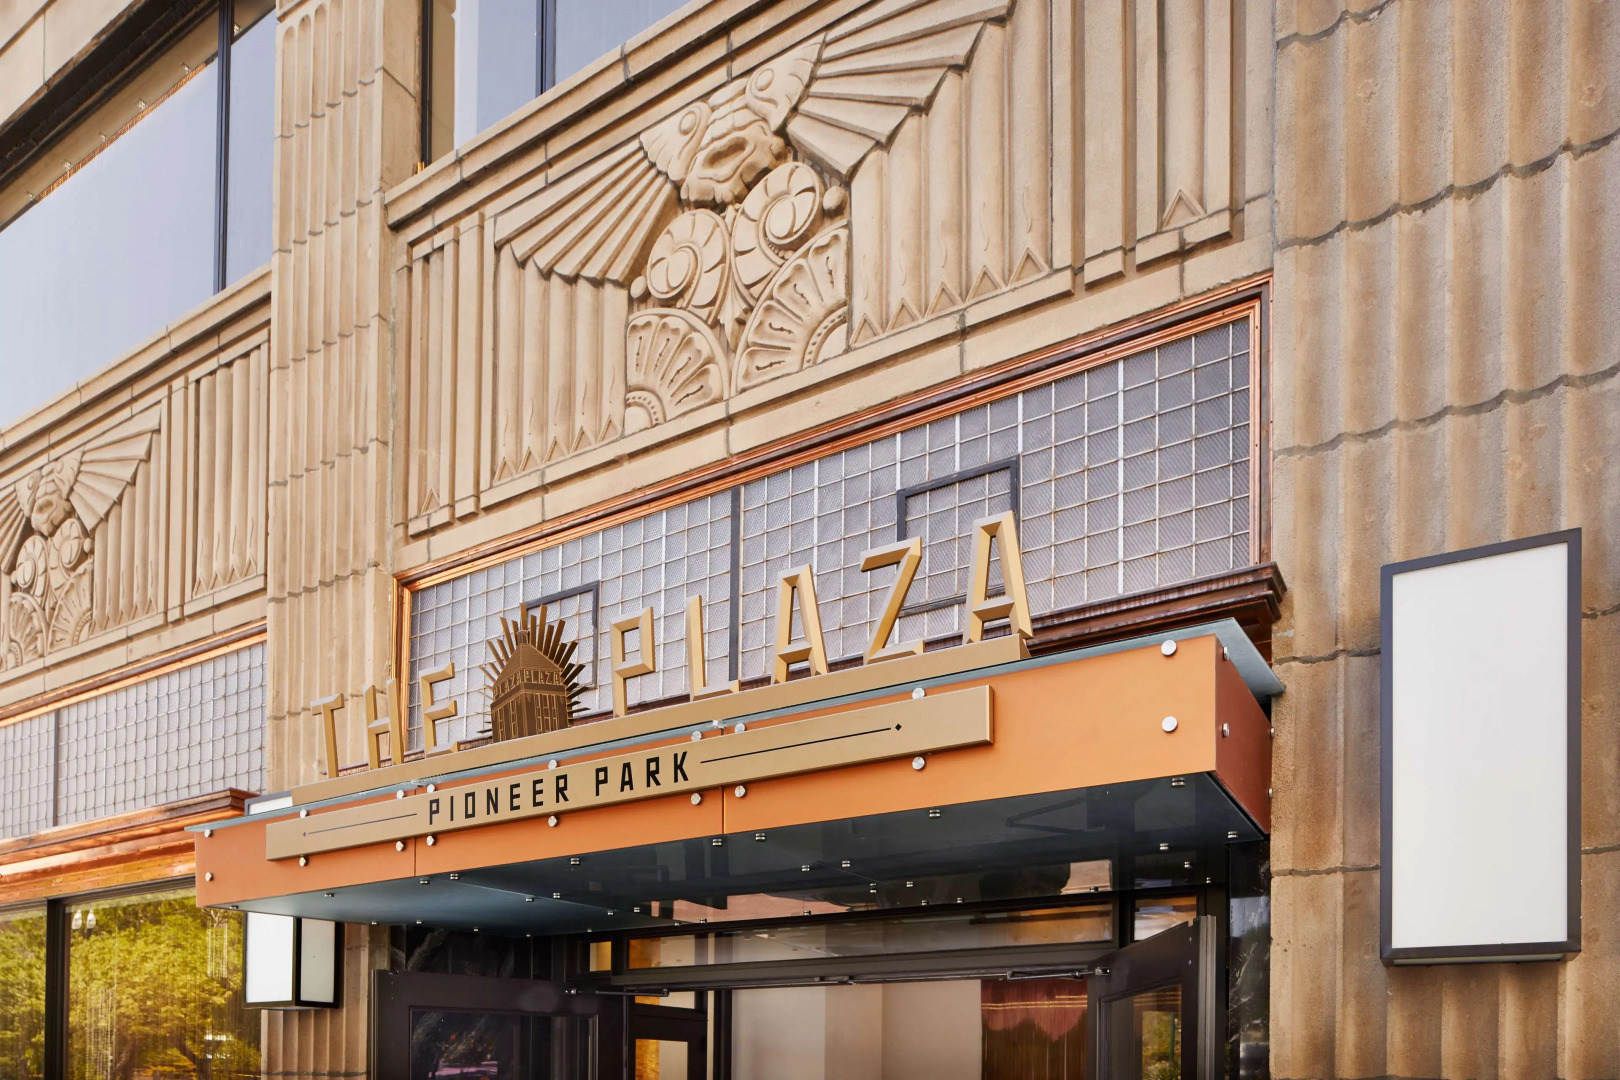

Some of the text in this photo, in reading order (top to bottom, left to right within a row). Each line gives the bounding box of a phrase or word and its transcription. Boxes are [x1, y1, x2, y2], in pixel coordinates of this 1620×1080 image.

[310, 510, 1034, 779] THE PLAZA
[523, 669, 561, 686] PLAZA
[429, 751, 689, 826] PIONEER PARK
